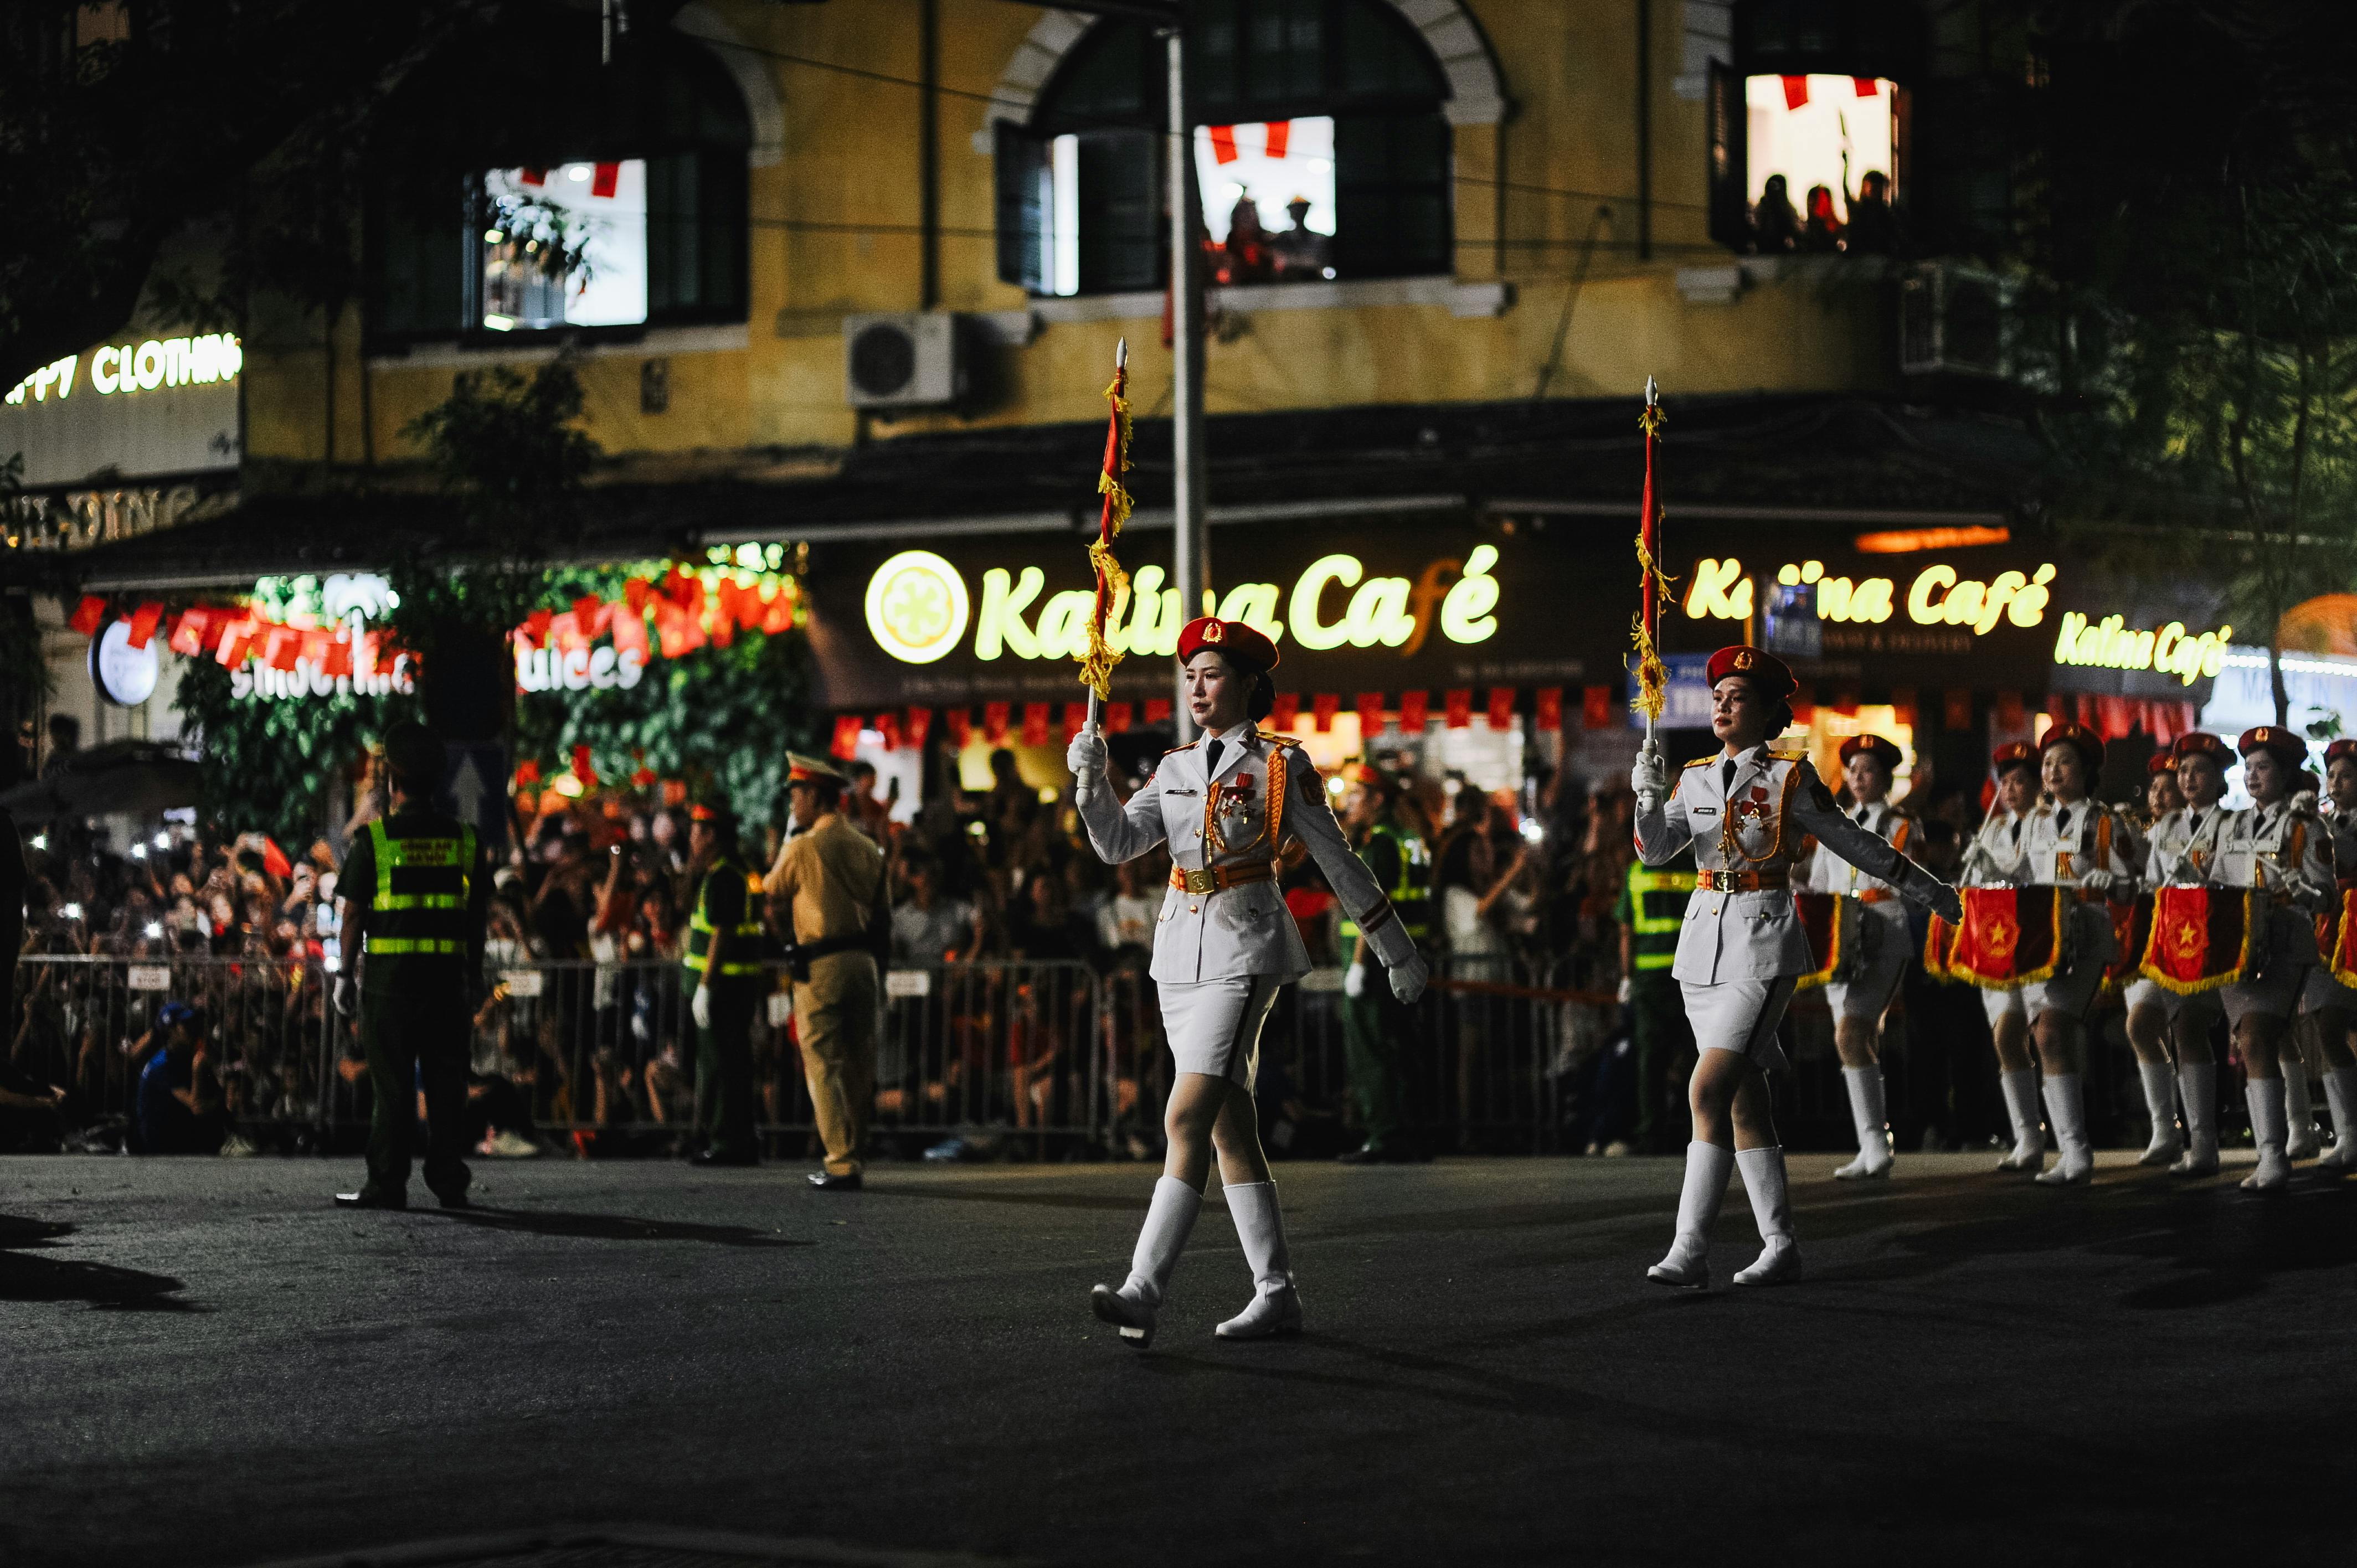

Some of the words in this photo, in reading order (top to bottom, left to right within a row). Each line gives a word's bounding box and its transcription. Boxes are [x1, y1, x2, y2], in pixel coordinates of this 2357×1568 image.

[91, 332, 243, 395] CLOTHING
[1289, 544, 1500, 656] Café
[1686, 558, 1893, 623] Kana
[1908, 563, 2056, 636] Café
[516, 639, 642, 692] uices
[2054, 611, 2155, 670] Kalina
[2154, 621, 2232, 687] Café
